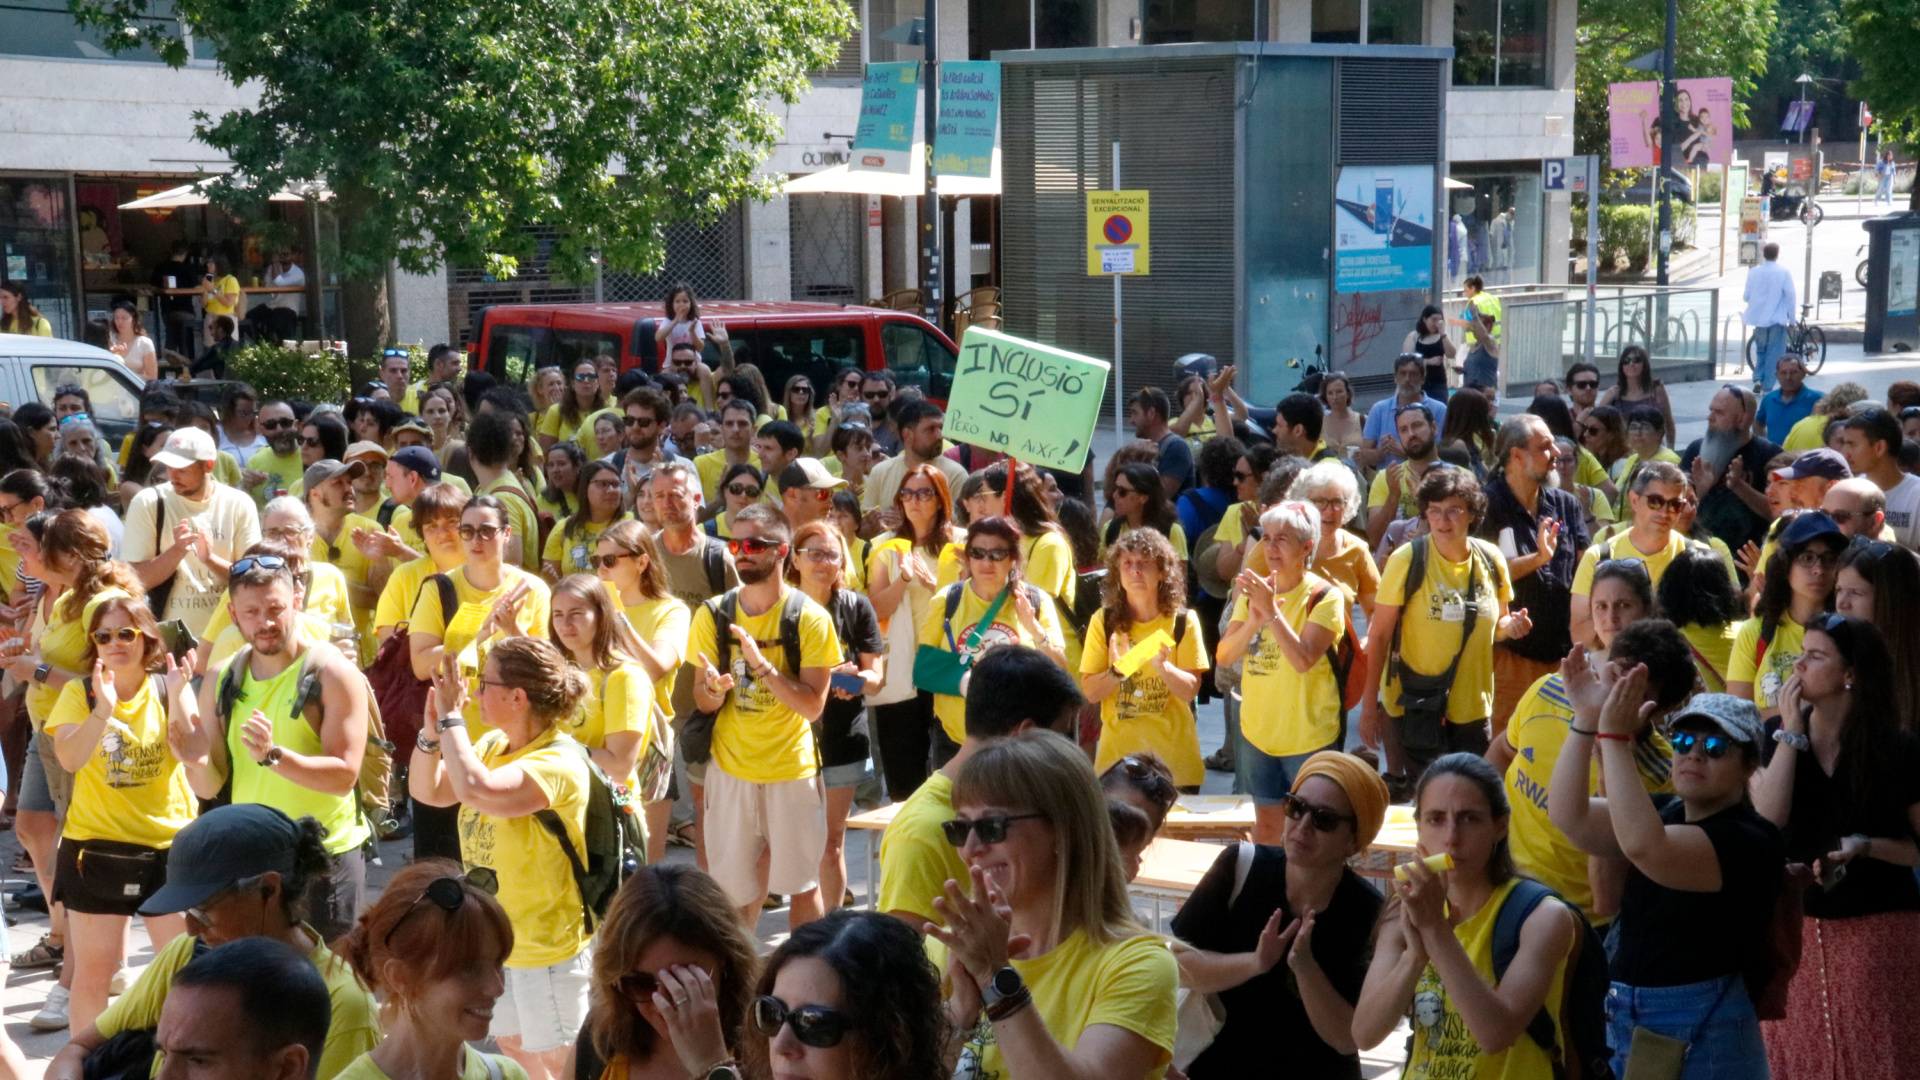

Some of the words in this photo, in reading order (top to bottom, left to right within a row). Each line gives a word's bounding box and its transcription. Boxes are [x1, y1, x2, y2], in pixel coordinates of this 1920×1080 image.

[864, 157, 880, 165] NOEL
[1548, 162, 1562, 186] P
[1092, 196, 1144, 204] SENYALITZACIÓ
[979, 382, 1046, 421] SÍ
[990, 430, 1009, 445] NO
